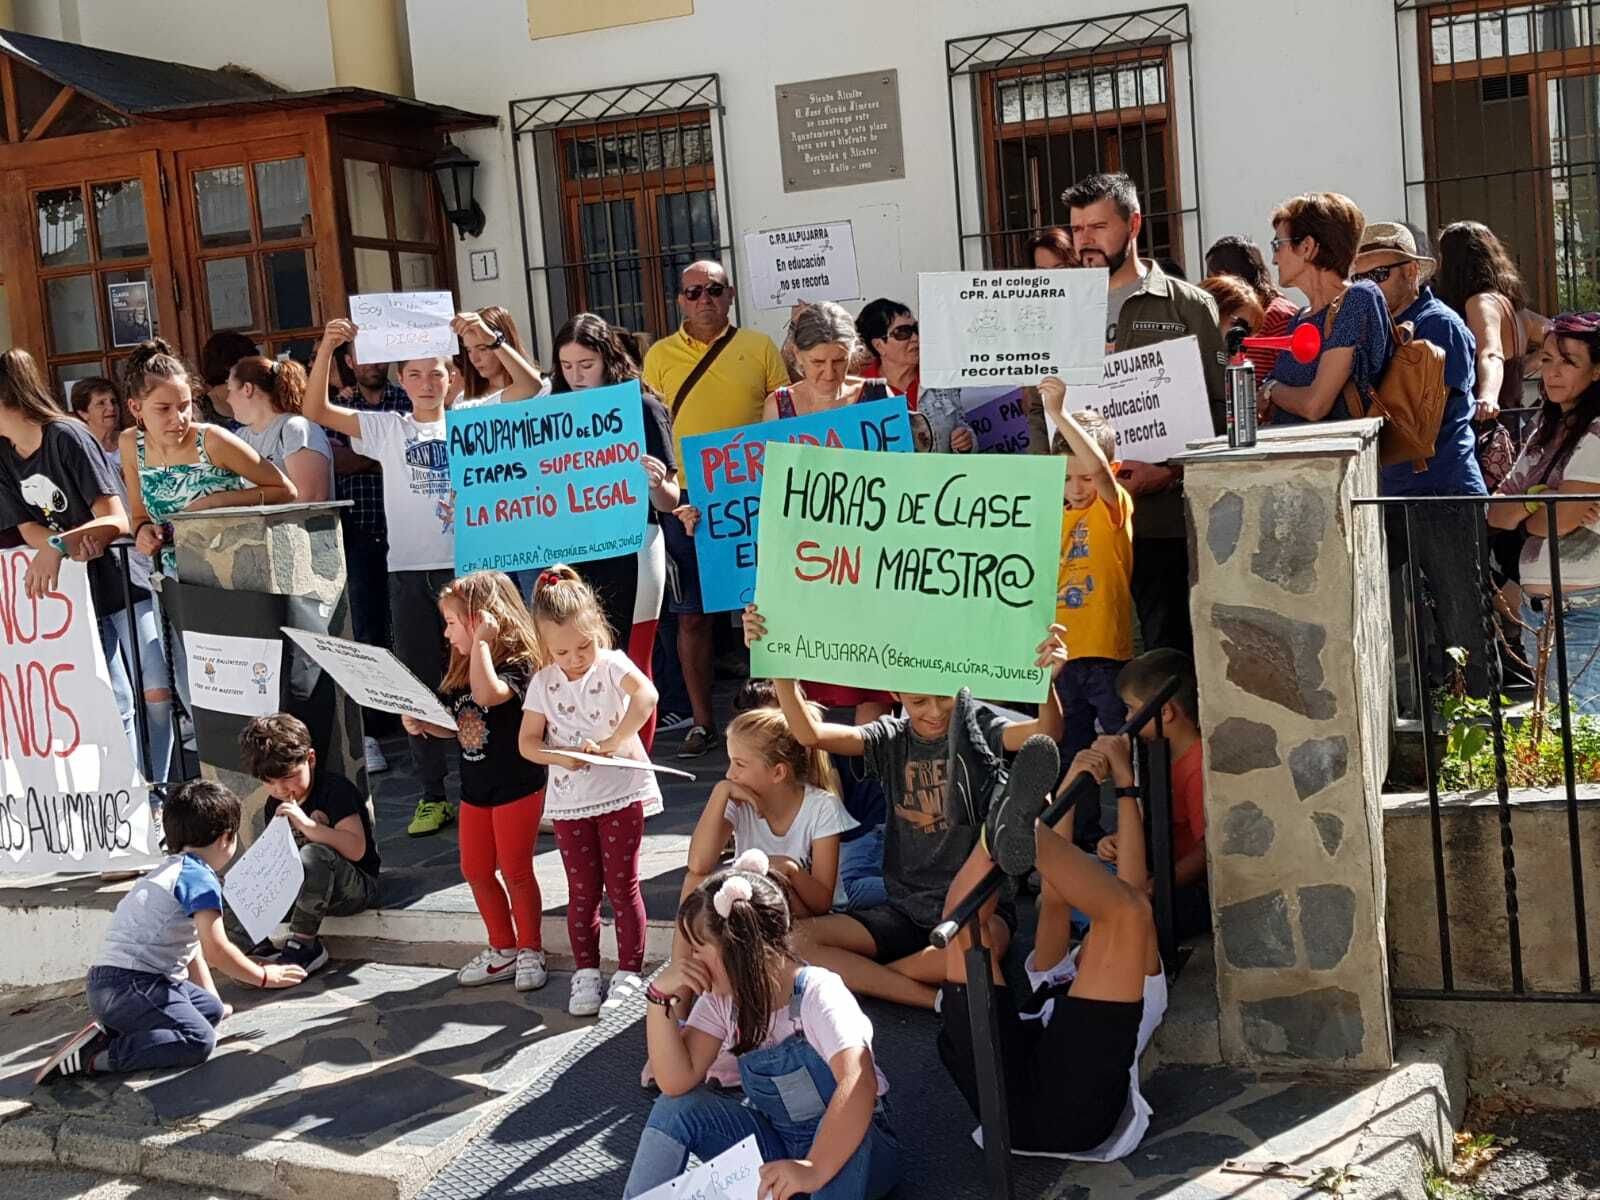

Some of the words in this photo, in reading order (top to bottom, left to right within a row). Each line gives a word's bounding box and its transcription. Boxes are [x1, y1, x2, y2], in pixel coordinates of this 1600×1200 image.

[776, 259, 786, 272] En
[788, 253, 826, 271] educación
[780, 279, 790, 290] no
[791, 278, 800, 289] se
[801, 273, 830, 289] recorta
[972, 278, 988, 287] En
[991, 277, 1002, 287] el
[1006, 276, 1050, 288] colegio
[960, 290, 988, 300] CPR.
[992, 288, 1066, 299] ALPUJARRA
[358, 302, 383, 317] Soy
[970, 352, 990, 363] no
[996, 351, 1051, 362] somos
[961, 364, 1059, 377] recortables
[1103, 390, 1160, 420] educación
[450, 411, 574, 457] AGRUPAMIENTO
[592, 408, 623, 438] DOS
[1124, 418, 1167, 445] recorta
[463, 462, 528, 487] ETAPAS
[539, 441, 640, 475] SUPERANDO
[465, 506, 489, 528] LA
[567, 479, 636, 514] LEGAL
[783, 467, 887, 531] HORAS
[897, 493, 930, 524] DE
[935, 474, 1032, 528] CLASE
[795, 540, 862, 585] SIN
[876, 546, 1035, 607] MAESTR@
